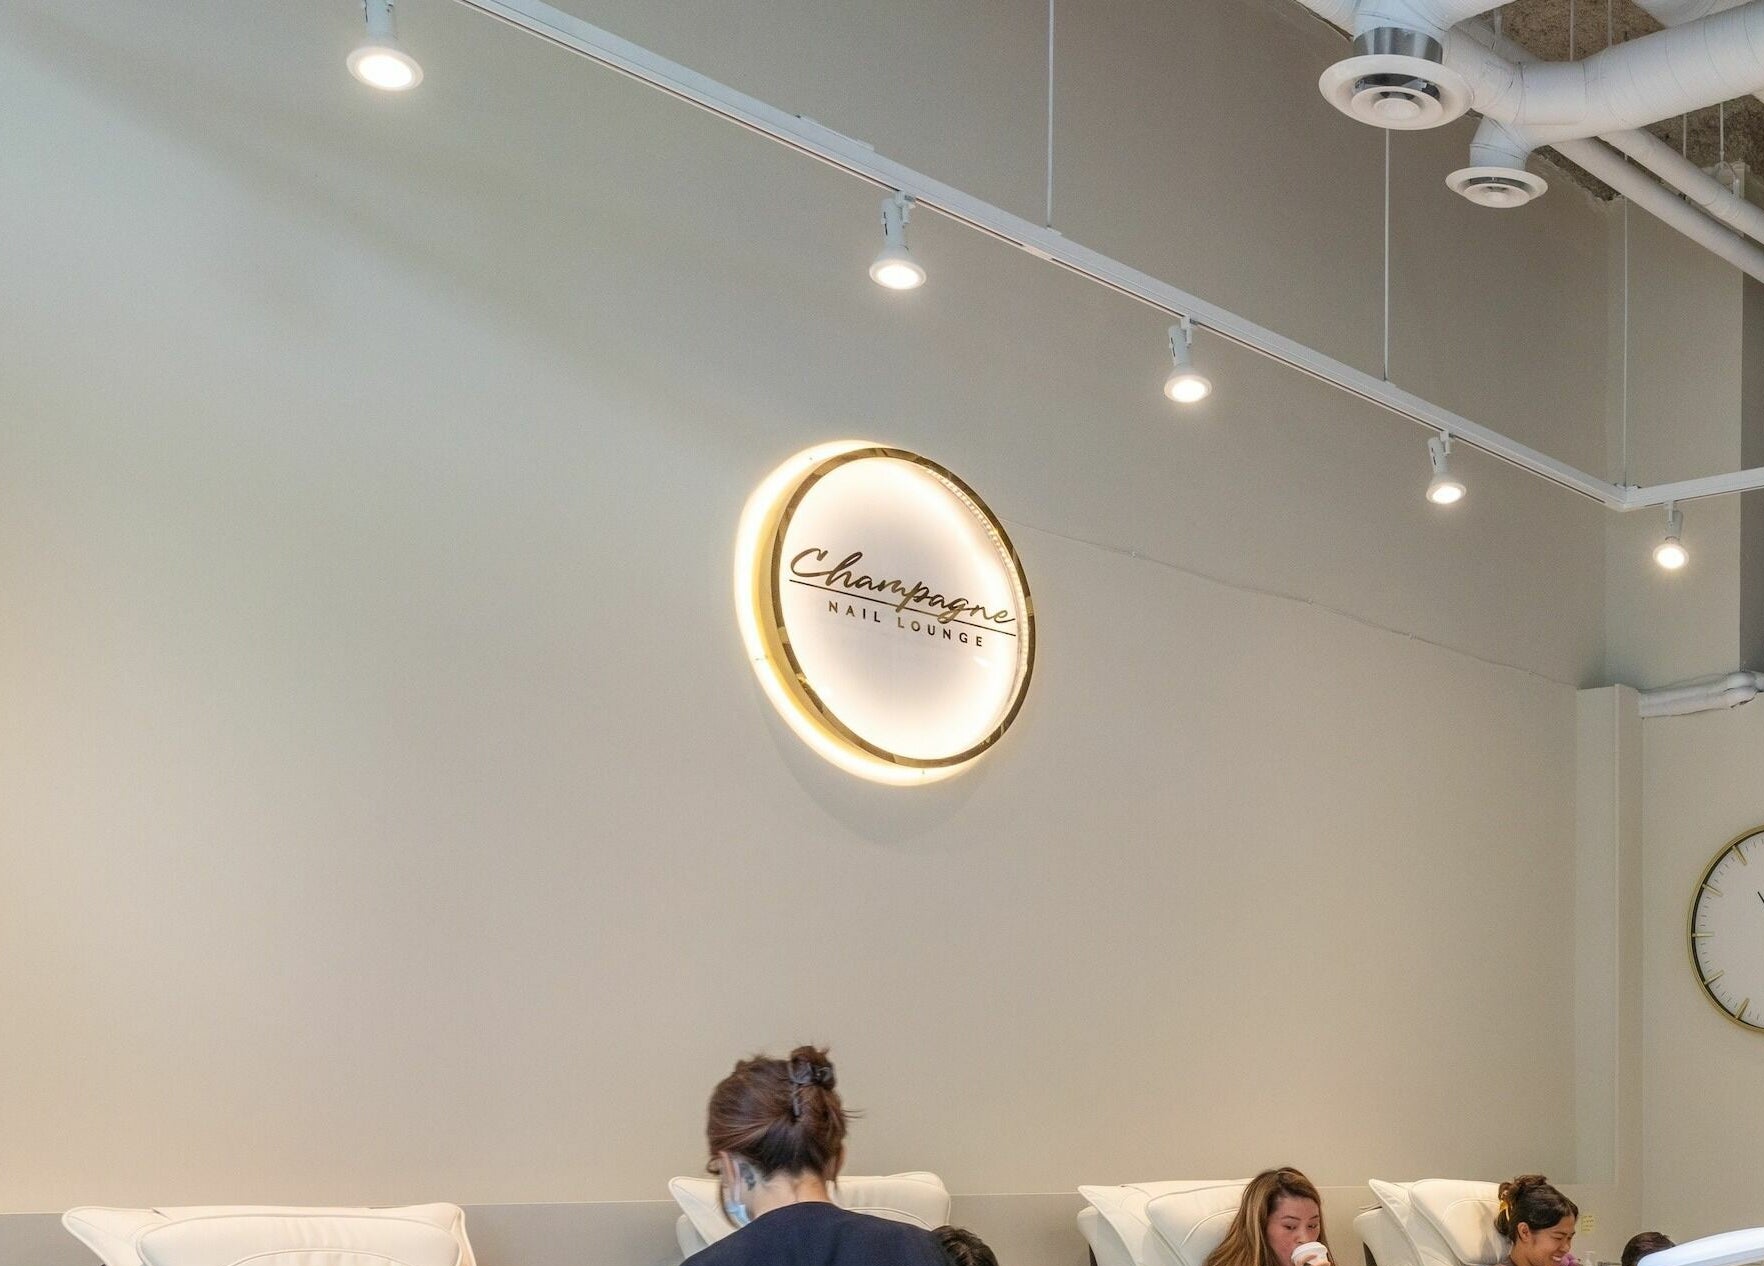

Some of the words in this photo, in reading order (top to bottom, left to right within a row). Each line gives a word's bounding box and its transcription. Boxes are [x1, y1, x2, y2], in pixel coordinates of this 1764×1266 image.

[790, 548, 1016, 624] Champagne
[829, 601, 881, 623] NAIL
[897, 617, 983, 647] LOUNGE
